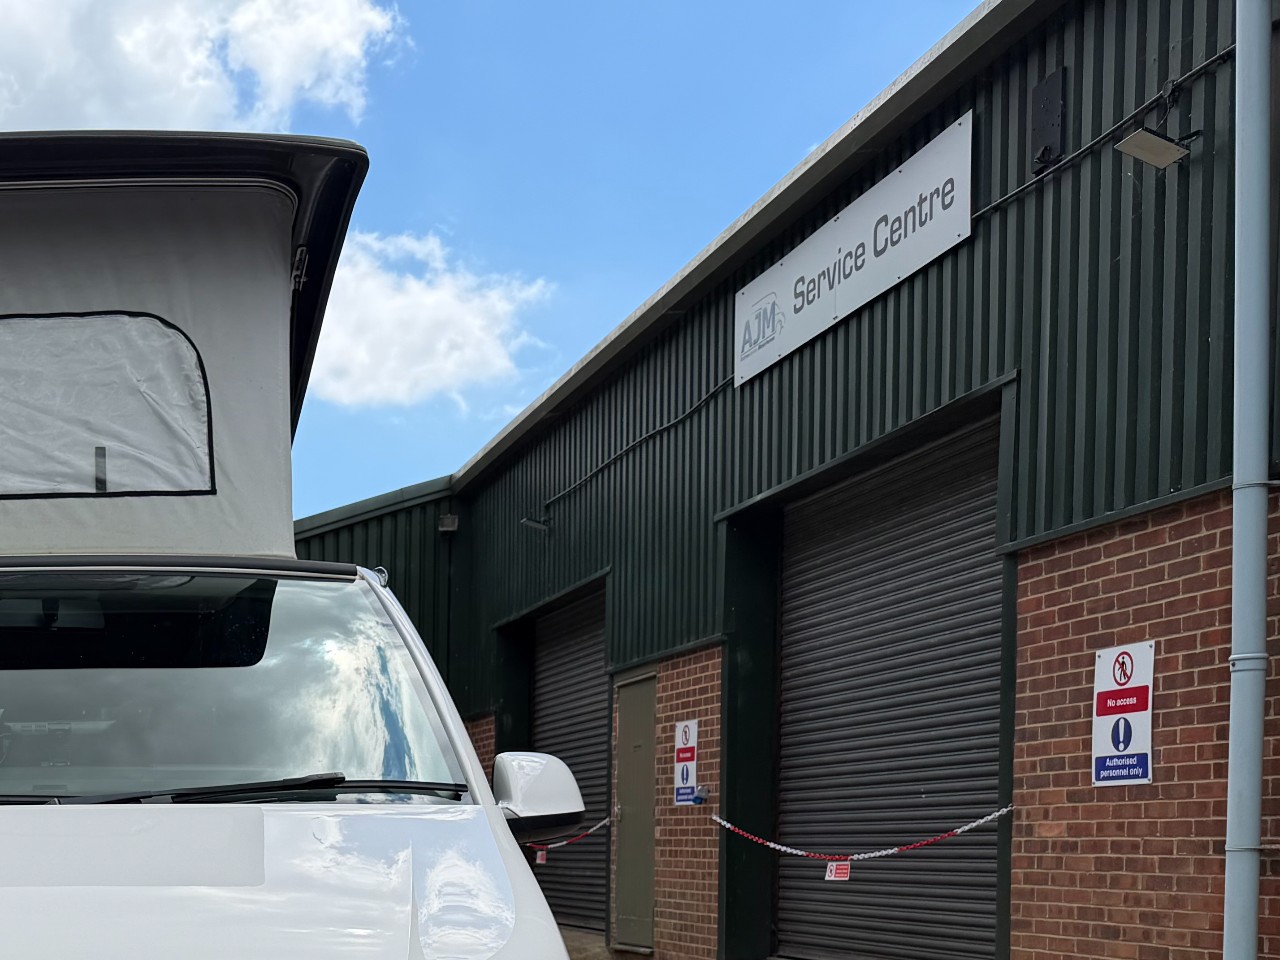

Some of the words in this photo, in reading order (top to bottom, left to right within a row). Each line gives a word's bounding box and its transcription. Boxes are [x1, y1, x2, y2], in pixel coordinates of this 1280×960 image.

[793, 242, 866, 315] Service
[873, 177, 955, 258] Centre
[740, 300, 776, 354] AJM
[1107, 699, 1115, 707] No
[1116, 697, 1136, 706] access
[1106, 756, 1137, 767] Authorised
[1100, 767, 1128, 778] personnel
[1129, 767, 1142, 776] only
